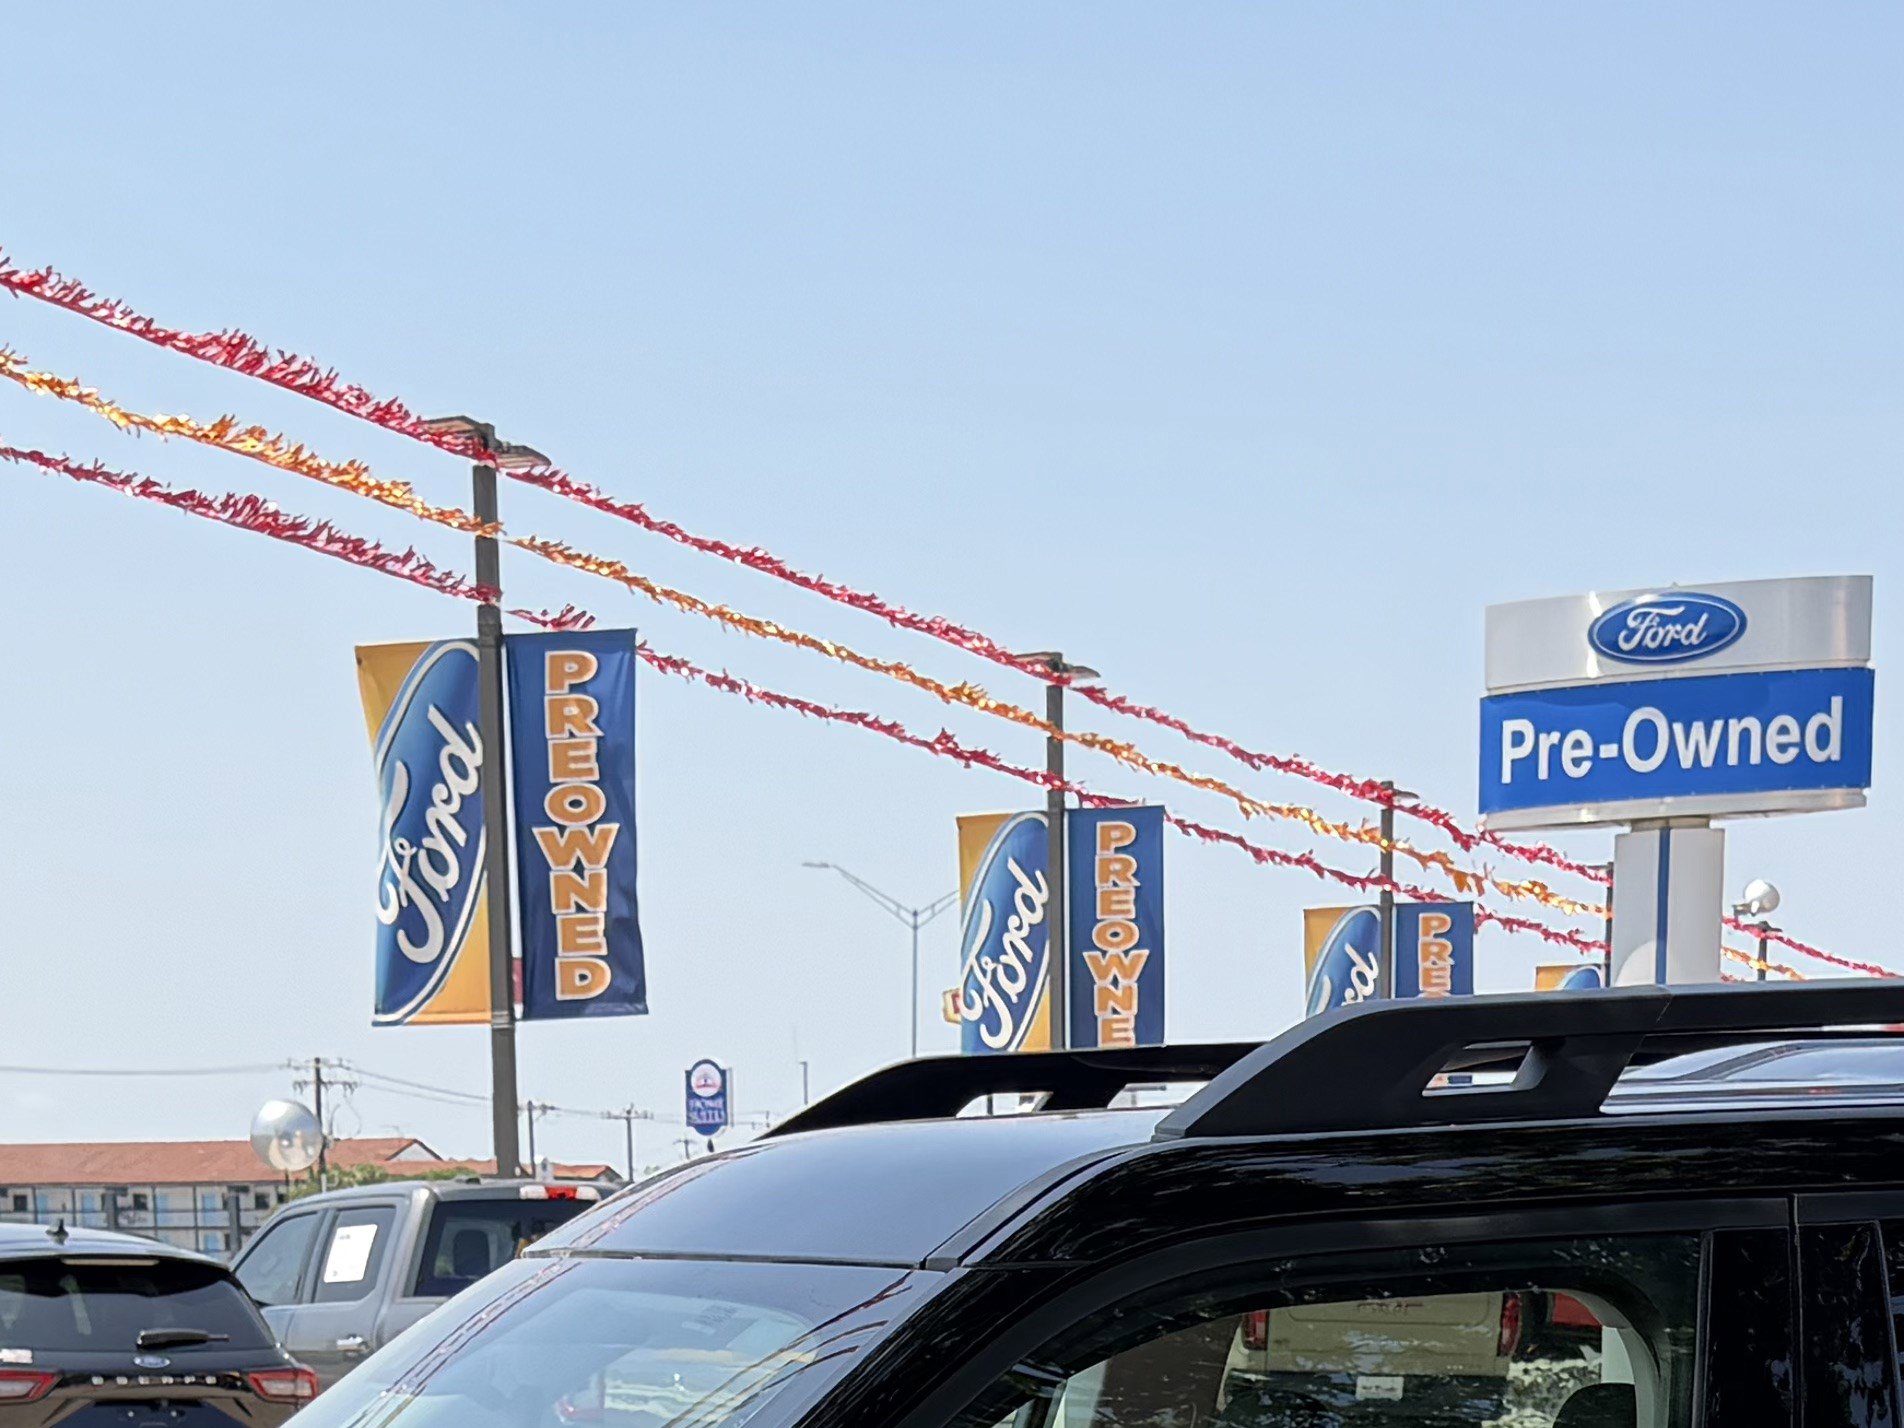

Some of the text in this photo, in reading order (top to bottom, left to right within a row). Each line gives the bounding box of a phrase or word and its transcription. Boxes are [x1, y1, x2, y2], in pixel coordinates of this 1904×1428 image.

[1618, 605, 1709, 653] Ford
[375, 703, 484, 965] Ford
[531, 649, 620, 1002] PREOWNED
[1500, 695, 1844, 785] Pre-Owned
[960, 856, 1050, 1049] Ford
[1082, 821, 1150, 1048] PREOWNE
[1417, 912, 1456, 999] PRE
